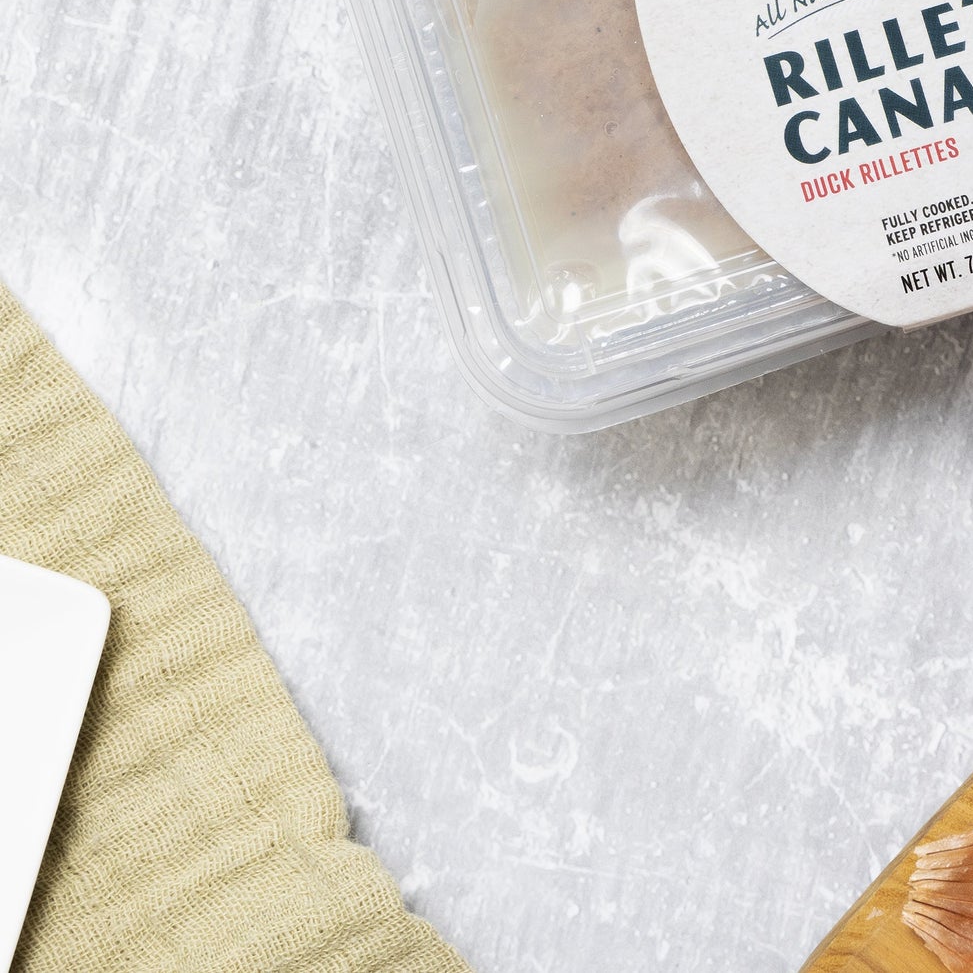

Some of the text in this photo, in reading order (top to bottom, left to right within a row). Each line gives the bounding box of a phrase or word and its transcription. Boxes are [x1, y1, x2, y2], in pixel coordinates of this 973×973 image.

[800, 136, 960, 203] DUCK RILLETTES
[881, 209, 918, 231] FULLY
[886, 226, 917, 246] KEEP
[912, 234, 959, 259] ARTIFICIAL
[900, 268, 931, 294] NET
[933, 260, 963, 284] WT.
[964, 254, 973, 274] 7
